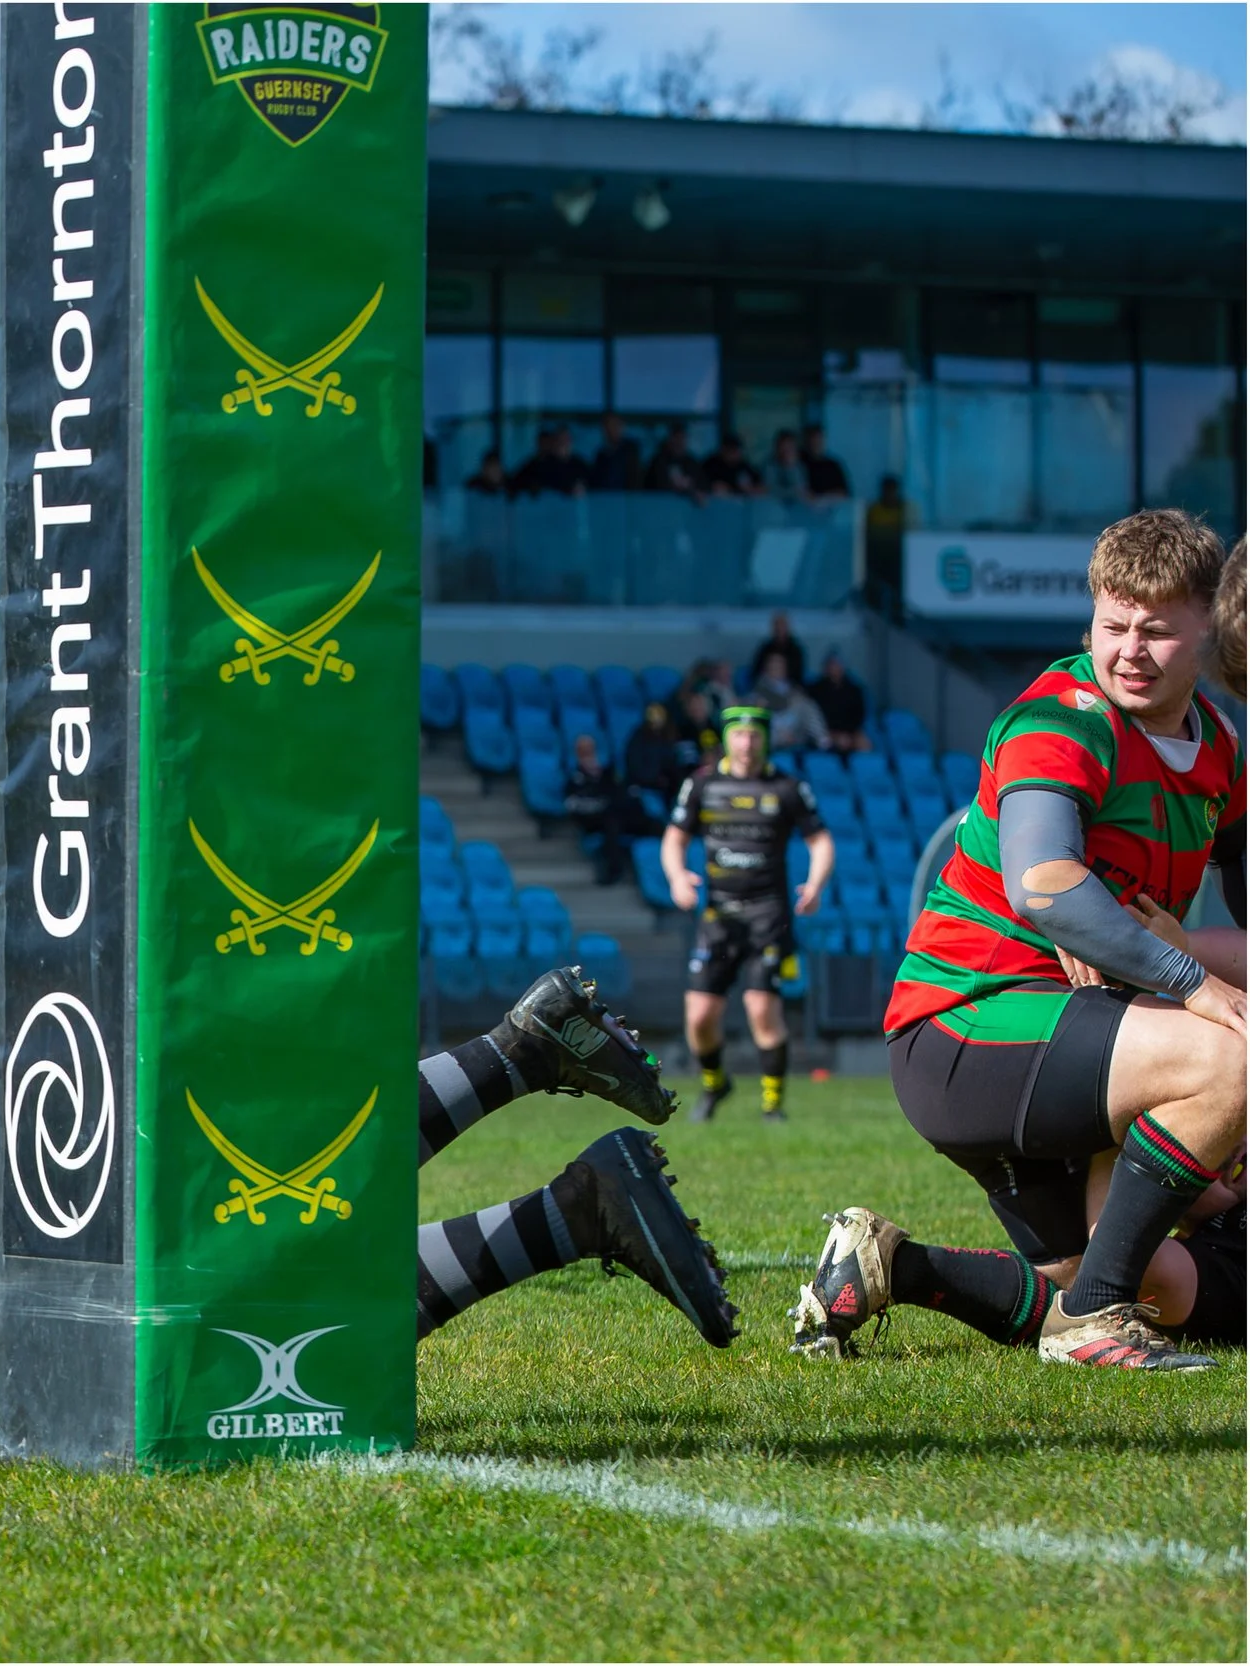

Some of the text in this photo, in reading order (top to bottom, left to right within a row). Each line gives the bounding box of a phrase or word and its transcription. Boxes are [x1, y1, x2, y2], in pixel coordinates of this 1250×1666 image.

[210, 19, 372, 74] RAIDERS
[254, 80, 333, 103] GUERNSEY
[267, 103, 318, 117] RUGBY CLUB
[980, 558, 1088, 596] Garenn
[32, 568, 92, 938] Grant
[207, 1411, 344, 1440] GILBERT
